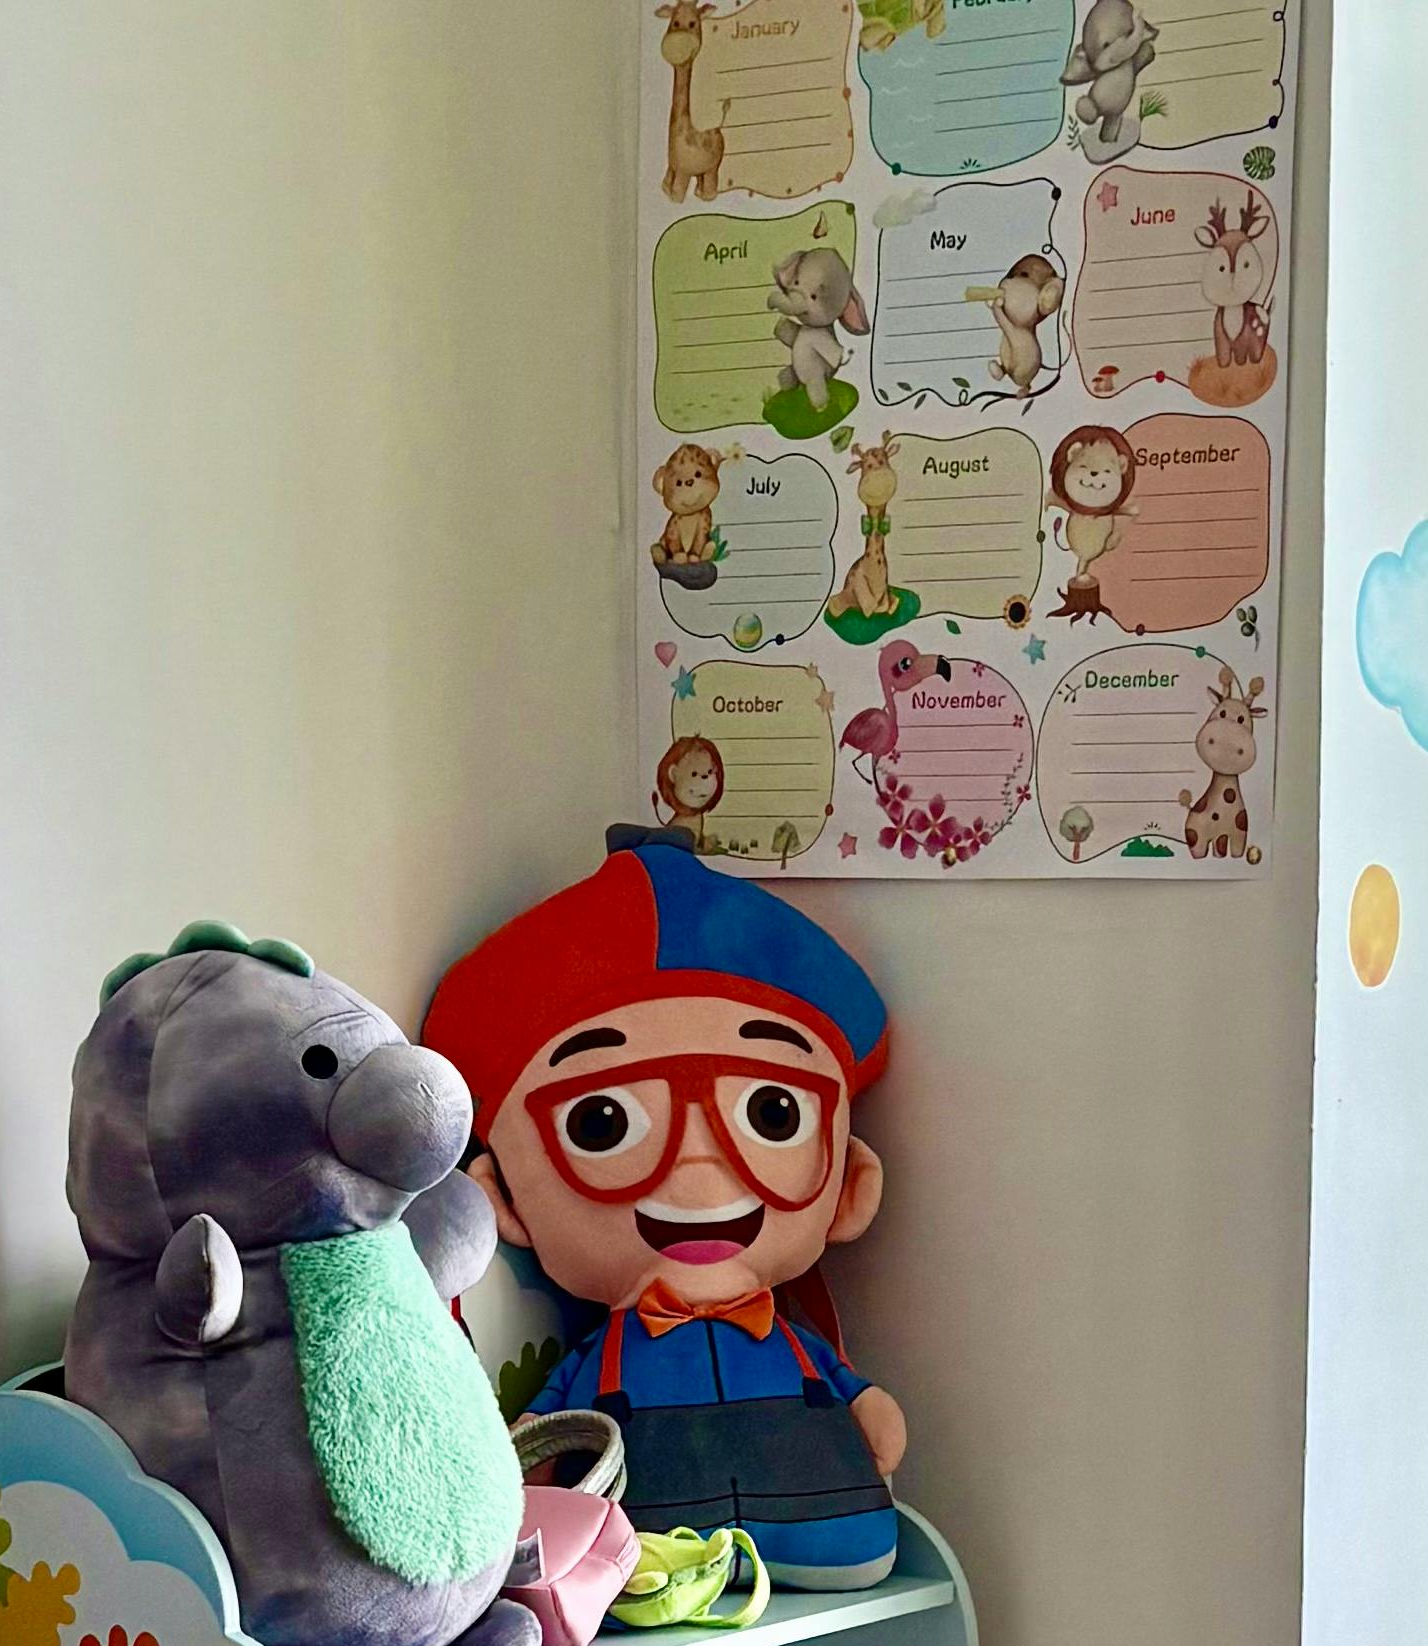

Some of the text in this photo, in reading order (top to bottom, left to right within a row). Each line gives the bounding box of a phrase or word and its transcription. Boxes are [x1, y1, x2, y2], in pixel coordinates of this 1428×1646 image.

[732, 20, 800, 39] January
[1130, 206, 1176, 226] June
[930, 230, 967, 251] May
[704, 240, 748, 264] April
[923, 456, 990, 479] August
[1134, 444, 1241, 471] September
[746, 476, 781, 496] July
[1085, 669, 1180, 689] December
[712, 695, 784, 713] October
[912, 691, 1007, 710] November
